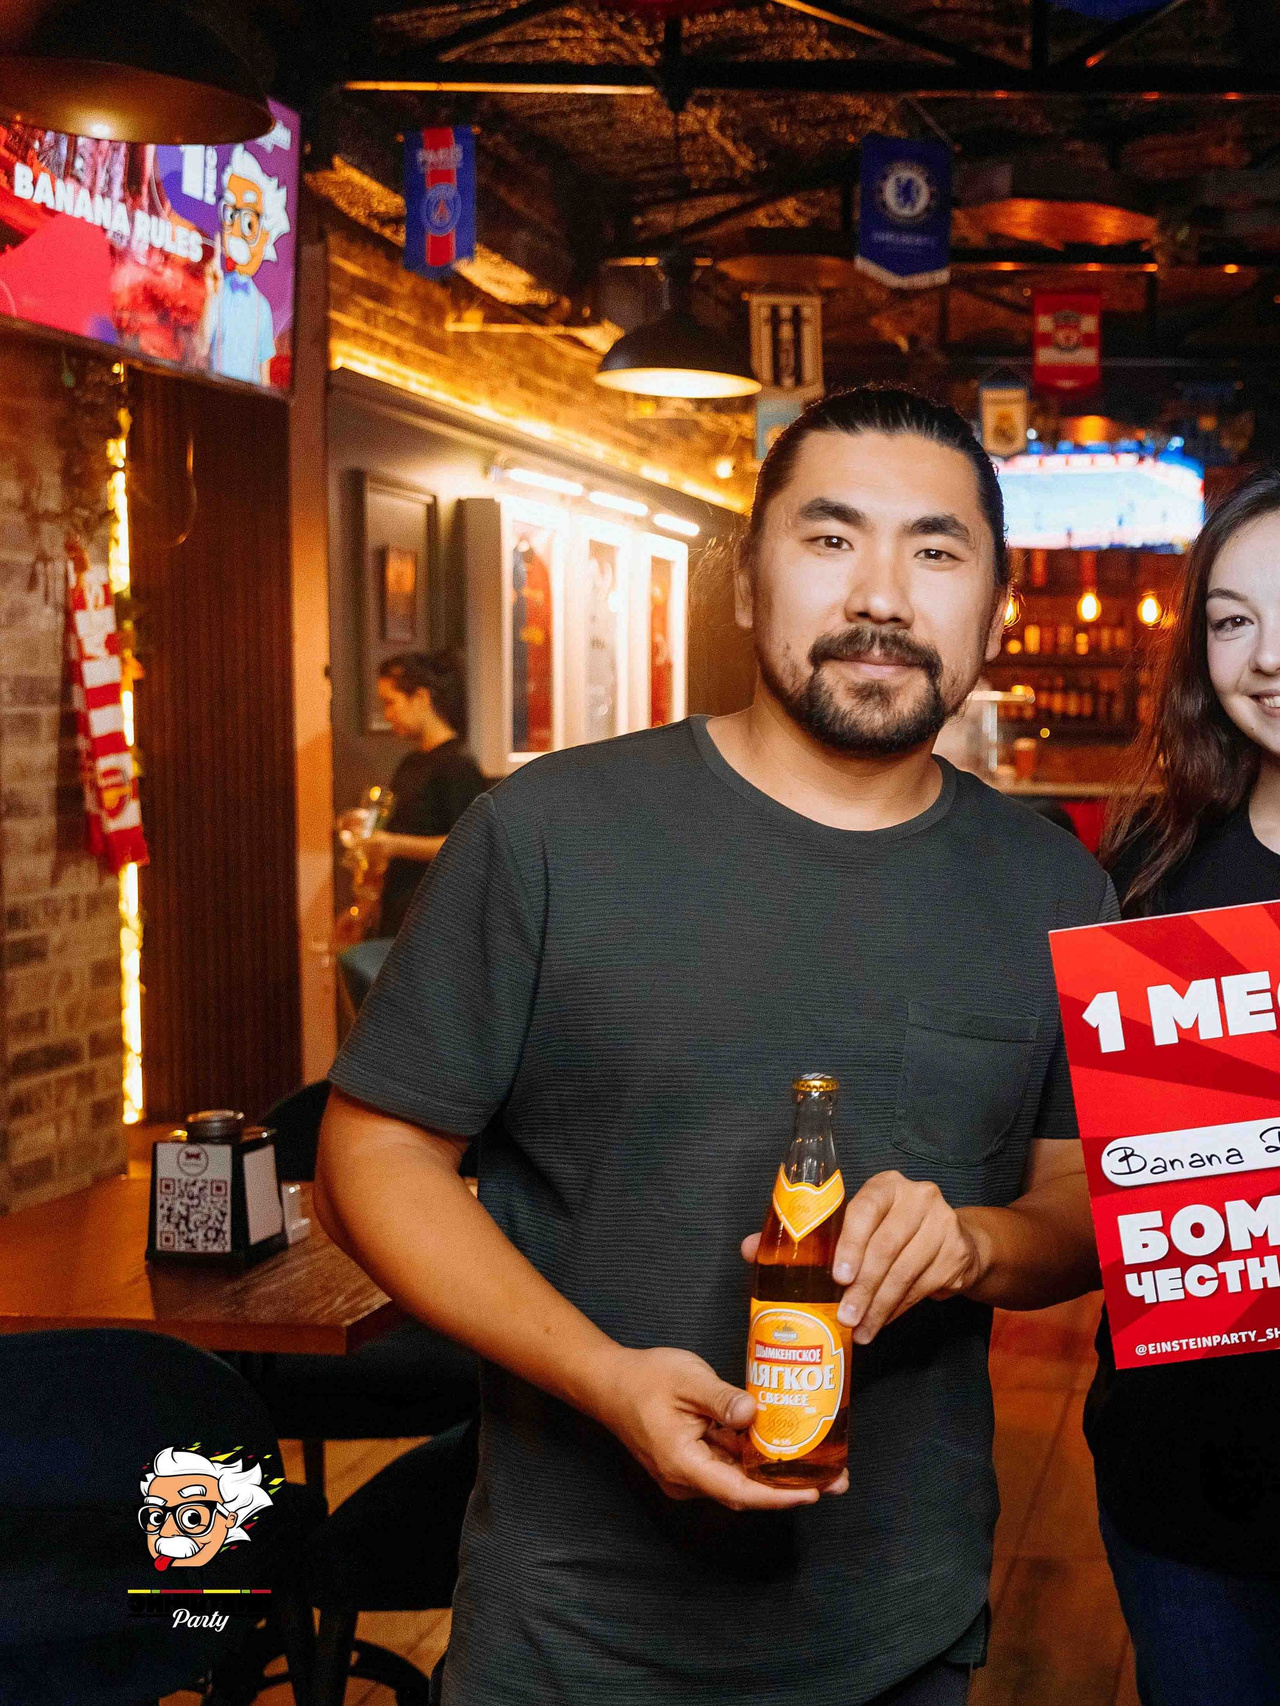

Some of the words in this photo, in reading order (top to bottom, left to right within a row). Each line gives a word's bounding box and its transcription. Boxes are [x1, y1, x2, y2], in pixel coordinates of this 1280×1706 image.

[14, 162, 131, 237] BANANA
[133, 208, 204, 262] RULES
[1081, 990, 1126, 1054] 1
[1107, 1145, 1245, 1176] Banana
[758, 1390, 810, 1406] СВЕЖЕЕ
